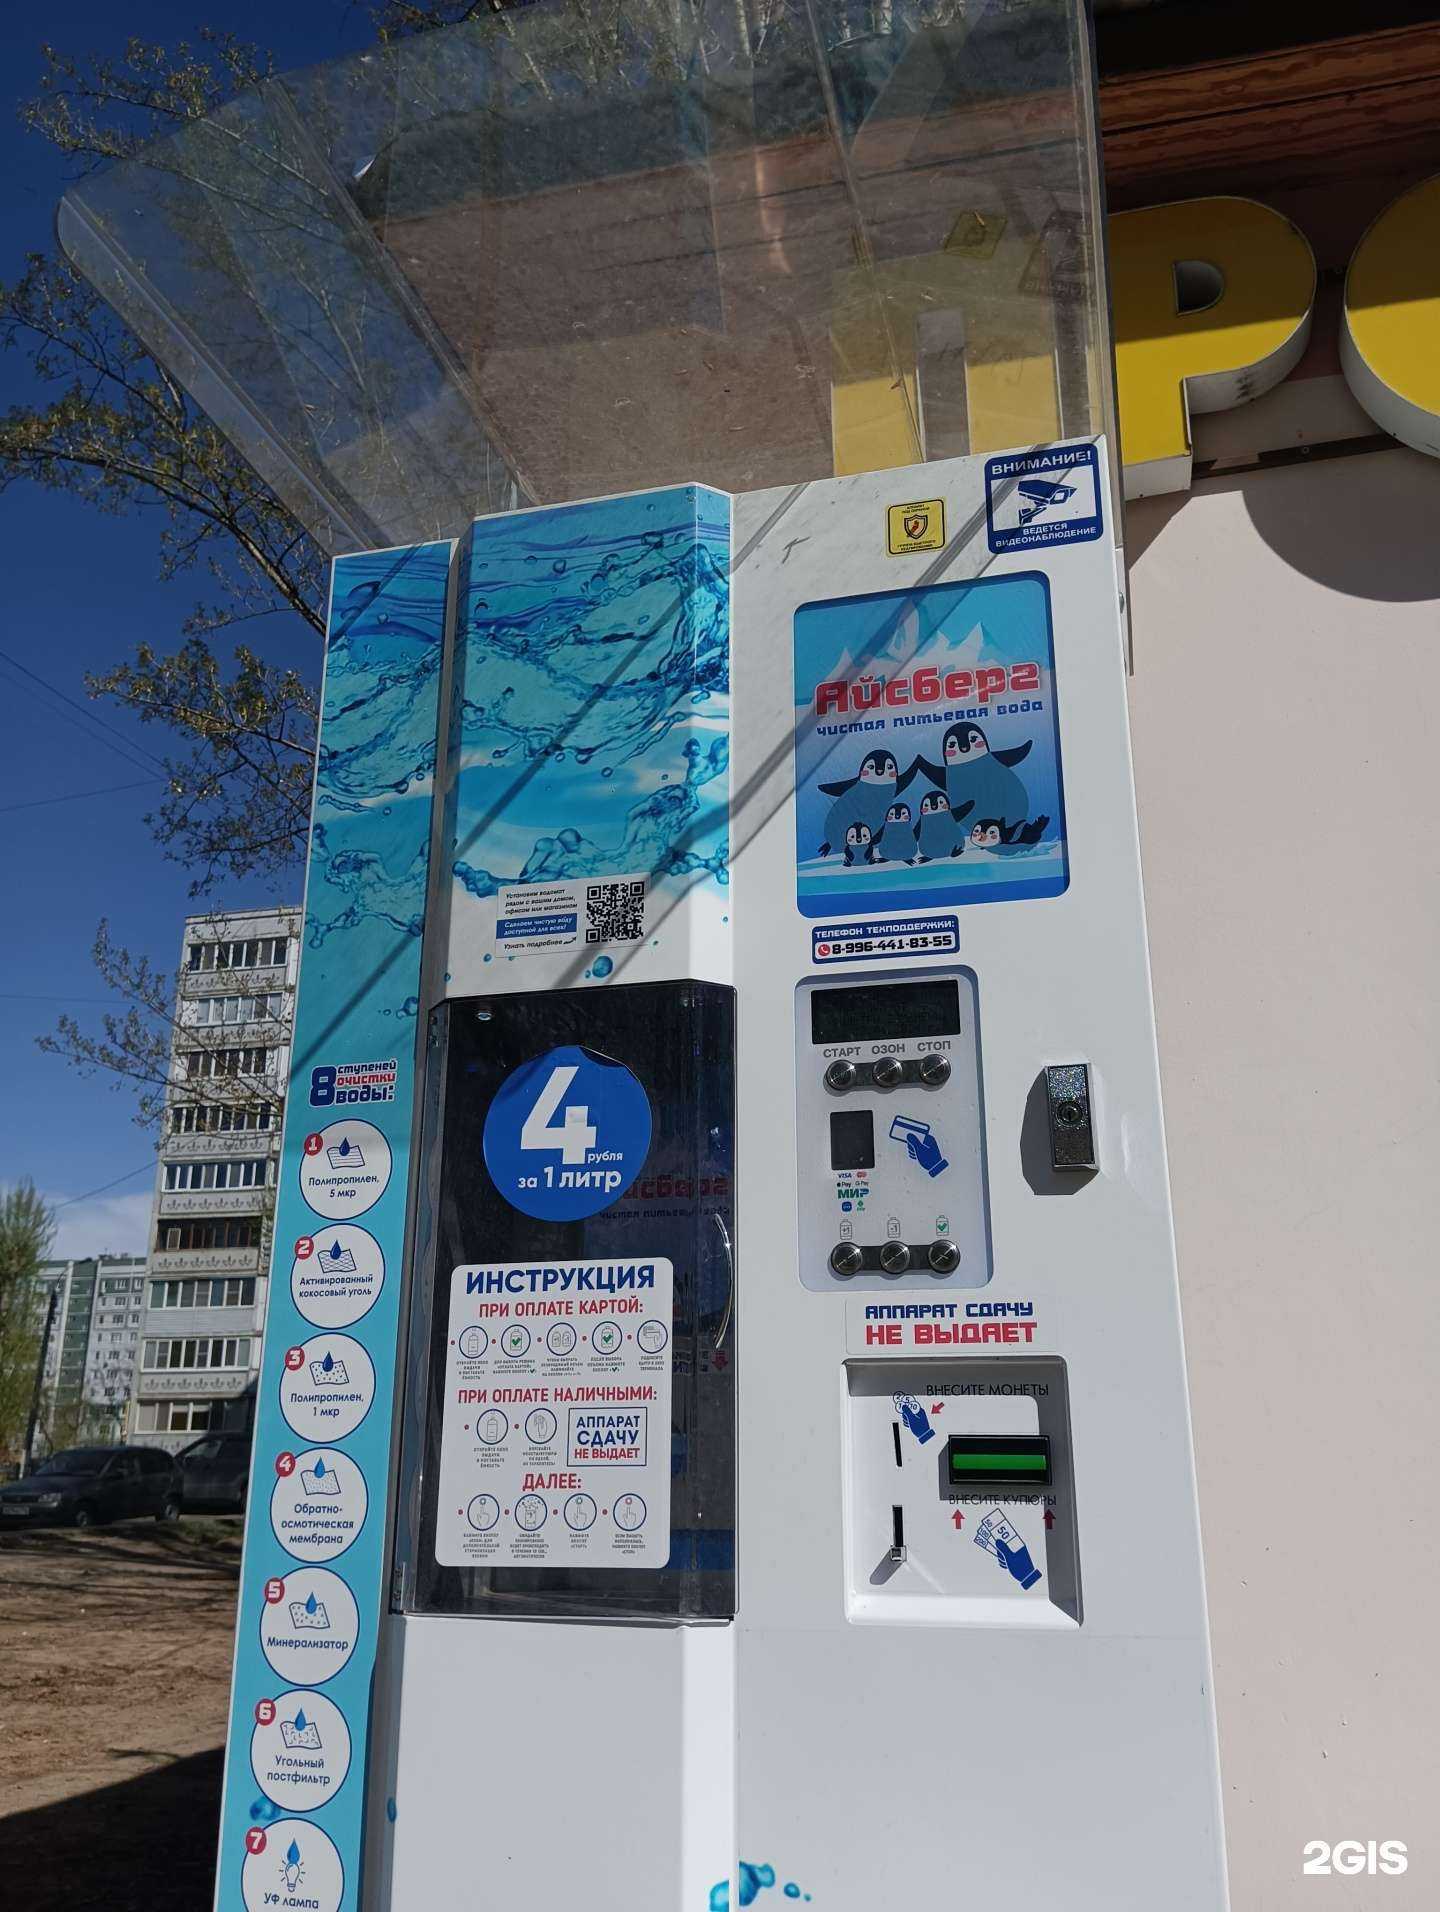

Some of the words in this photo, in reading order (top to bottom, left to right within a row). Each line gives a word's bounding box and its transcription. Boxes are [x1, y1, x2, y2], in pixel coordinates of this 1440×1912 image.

[992, 450, 1091, 475] ВНИМАНИЕ!
[995, 526, 1097, 548] ВИДЕОНАБЛЮДЕНИЕ
[1023, 522, 1068, 536] ВЕДЕТСЯ
[815, 662, 1040, 717] Айсберг
[816, 719, 886, 737] чистая
[893, 706, 989, 728] питьевая
[996, 700, 1044, 715] вода
[815, 927, 863, 939] ТЕЛЕФОН
[866, 920, 955, 935] ТЕХПОДДЕРЖКИ:
[527, 940, 563, 949] подробнее
[832, 935, 952, 955] 8-996-441-83-55
[823, 1046, 862, 1059] СТАРТ
[871, 1043, 906, 1055] ОЗОН
[917, 1040, 952, 1052] СТОП
[338, 1060, 397, 1075] ступеней
[310, 1066, 337, 1107] 8
[336, 1073, 396, 1086] очистки
[335, 1085, 394, 1104] воды:
[520, 1066, 597, 1165] 4
[309, 1136, 318, 1151] 1
[587, 1150, 623, 1164] рубля
[308, 1174, 380, 1187] Полипропилен,
[518, 1175, 538, 1188] за
[543, 1166, 554, 1188] 1
[559, 1169, 622, 1193] литр
[330, 1188, 335, 1198] 5
[337, 1188, 357, 1199] мкр
[838, 1188, 870, 1199] МИР
[296, 1239, 311, 1255] 2
[300, 1273, 374, 1286] Активированный
[466, 1264, 655, 1295] ИНСТРУКЦИЯ
[299, 1287, 347, 1298] кокосовый
[348, 1287, 372, 1298] уголь
[479, 1303, 510, 1318] ПРИ
[515, 1300, 573, 1317] ОПЛАТЕ
[579, 1295, 644, 1315] КАРТОЙ:
[865, 1303, 958, 1320] АППАРАТ
[965, 1302, 1034, 1317] СДАЧУ
[866, 1324, 903, 1345] НЕ
[914, 1322, 1038, 1345] ВЫДАЕТ
[288, 1350, 301, 1367] 3
[458, 1389, 487, 1404] ПРИ
[492, 1388, 549, 1403] ОПЛАТЕ
[554, 1386, 658, 1401] НАЛИЧНЫМИ:
[926, 1384, 985, 1396] ВНЕСИТЕ
[988, 1384, 1049, 1396] МОНЕТЫ
[290, 1393, 364, 1404] Полипропилен,
[319, 1407, 340, 1418] мкр
[576, 1415, 641, 1428] АППАРАТ
[576, 1430, 640, 1448] СДАЧУ
[574, 1448, 589, 1460] НЕ
[592, 1447, 641, 1461] ВЫДАЕТ
[279, 1456, 292, 1472] 4
[522, 1472, 582, 1492] ДАЛЕЕ:
[949, 1494, 1002, 1506] ВНЕСИТЕ
[1003, 1494, 1057, 1506] КУПЮРЫ
[294, 1503, 343, 1515] Обратно-
[281, 1519, 354, 1530] осмотическая
[997, 1526, 1010, 1539] 50
[288, 1533, 343, 1545] мембрана
[268, 1582, 281, 1599] 5
[267, 1636, 349, 1650] Минерализатор
[258, 1703, 272, 1720] 6
[275, 1755, 325, 1769] Угольный
[266, 1771, 331, 1787] постфильтр
[251, 1832, 263, 1849] 7
[282, 1896, 320, 1910] лампа
